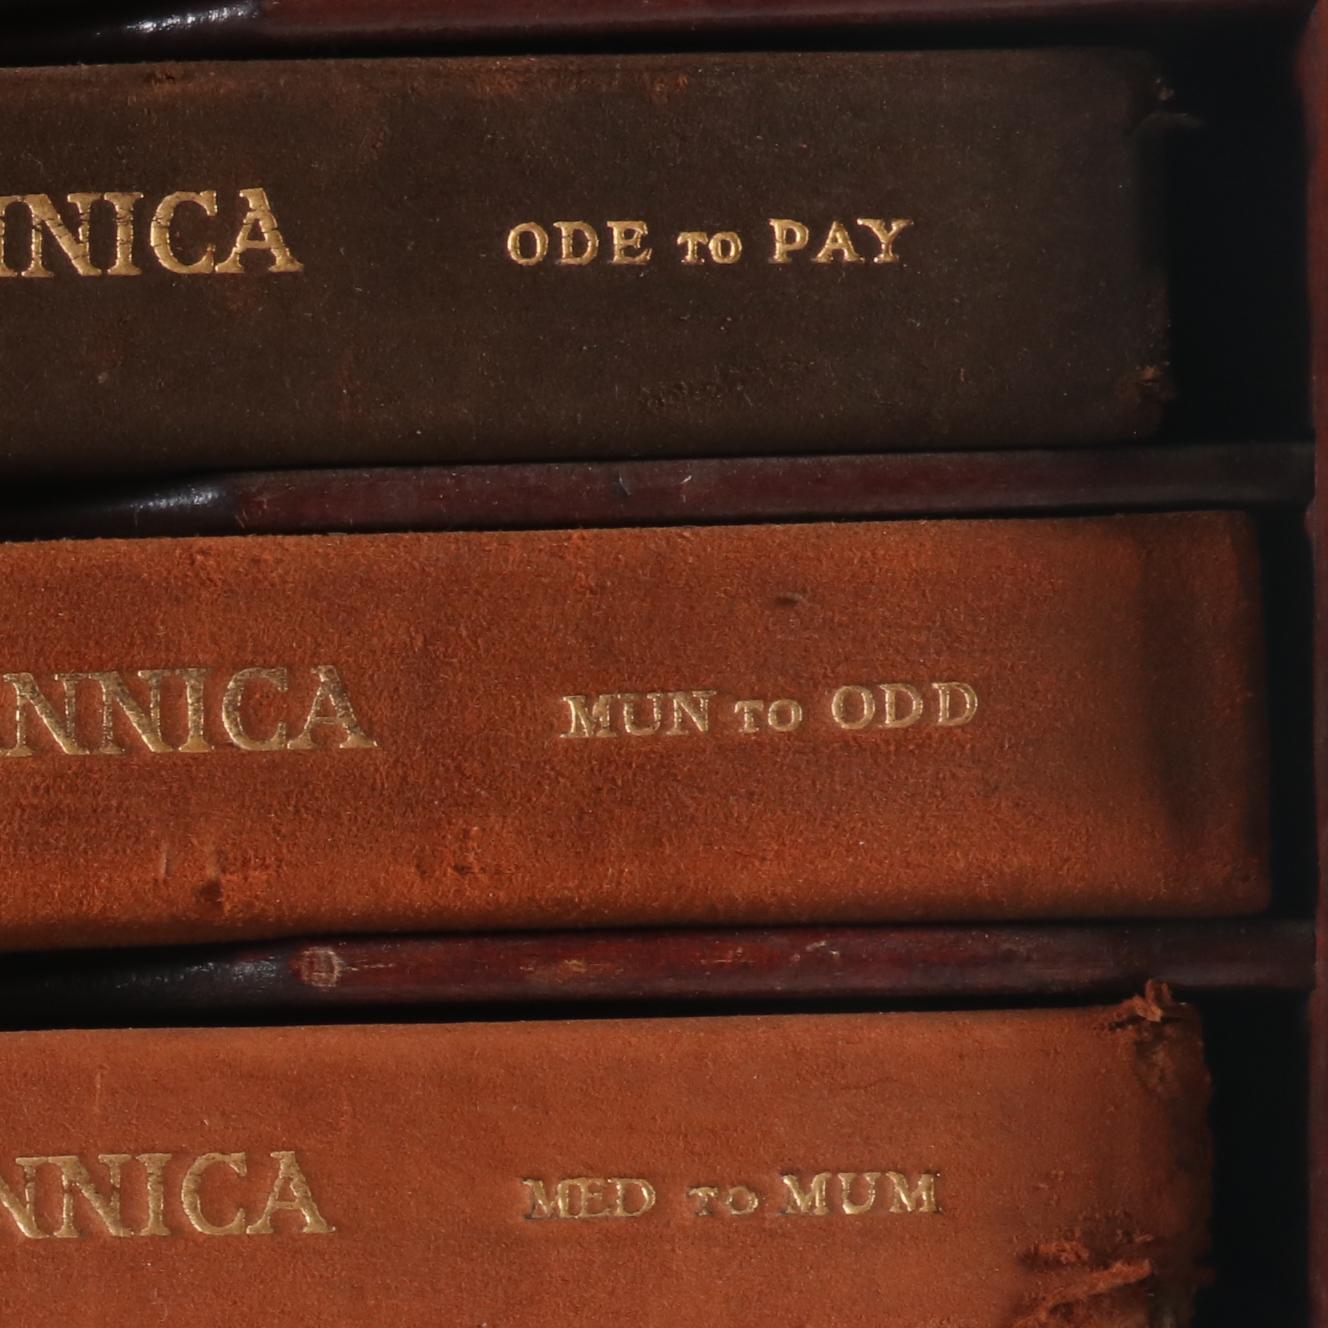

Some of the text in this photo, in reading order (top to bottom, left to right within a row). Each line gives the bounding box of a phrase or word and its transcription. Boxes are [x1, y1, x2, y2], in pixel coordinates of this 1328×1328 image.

[506, 219, 653, 267] ODE
[768, 216, 913, 265] PAY
[560, 690, 718, 740] MUN
[830, 681, 980, 731] ODD
[522, 1177, 658, 1220] MED
[780, 1170, 944, 1216] MUM
